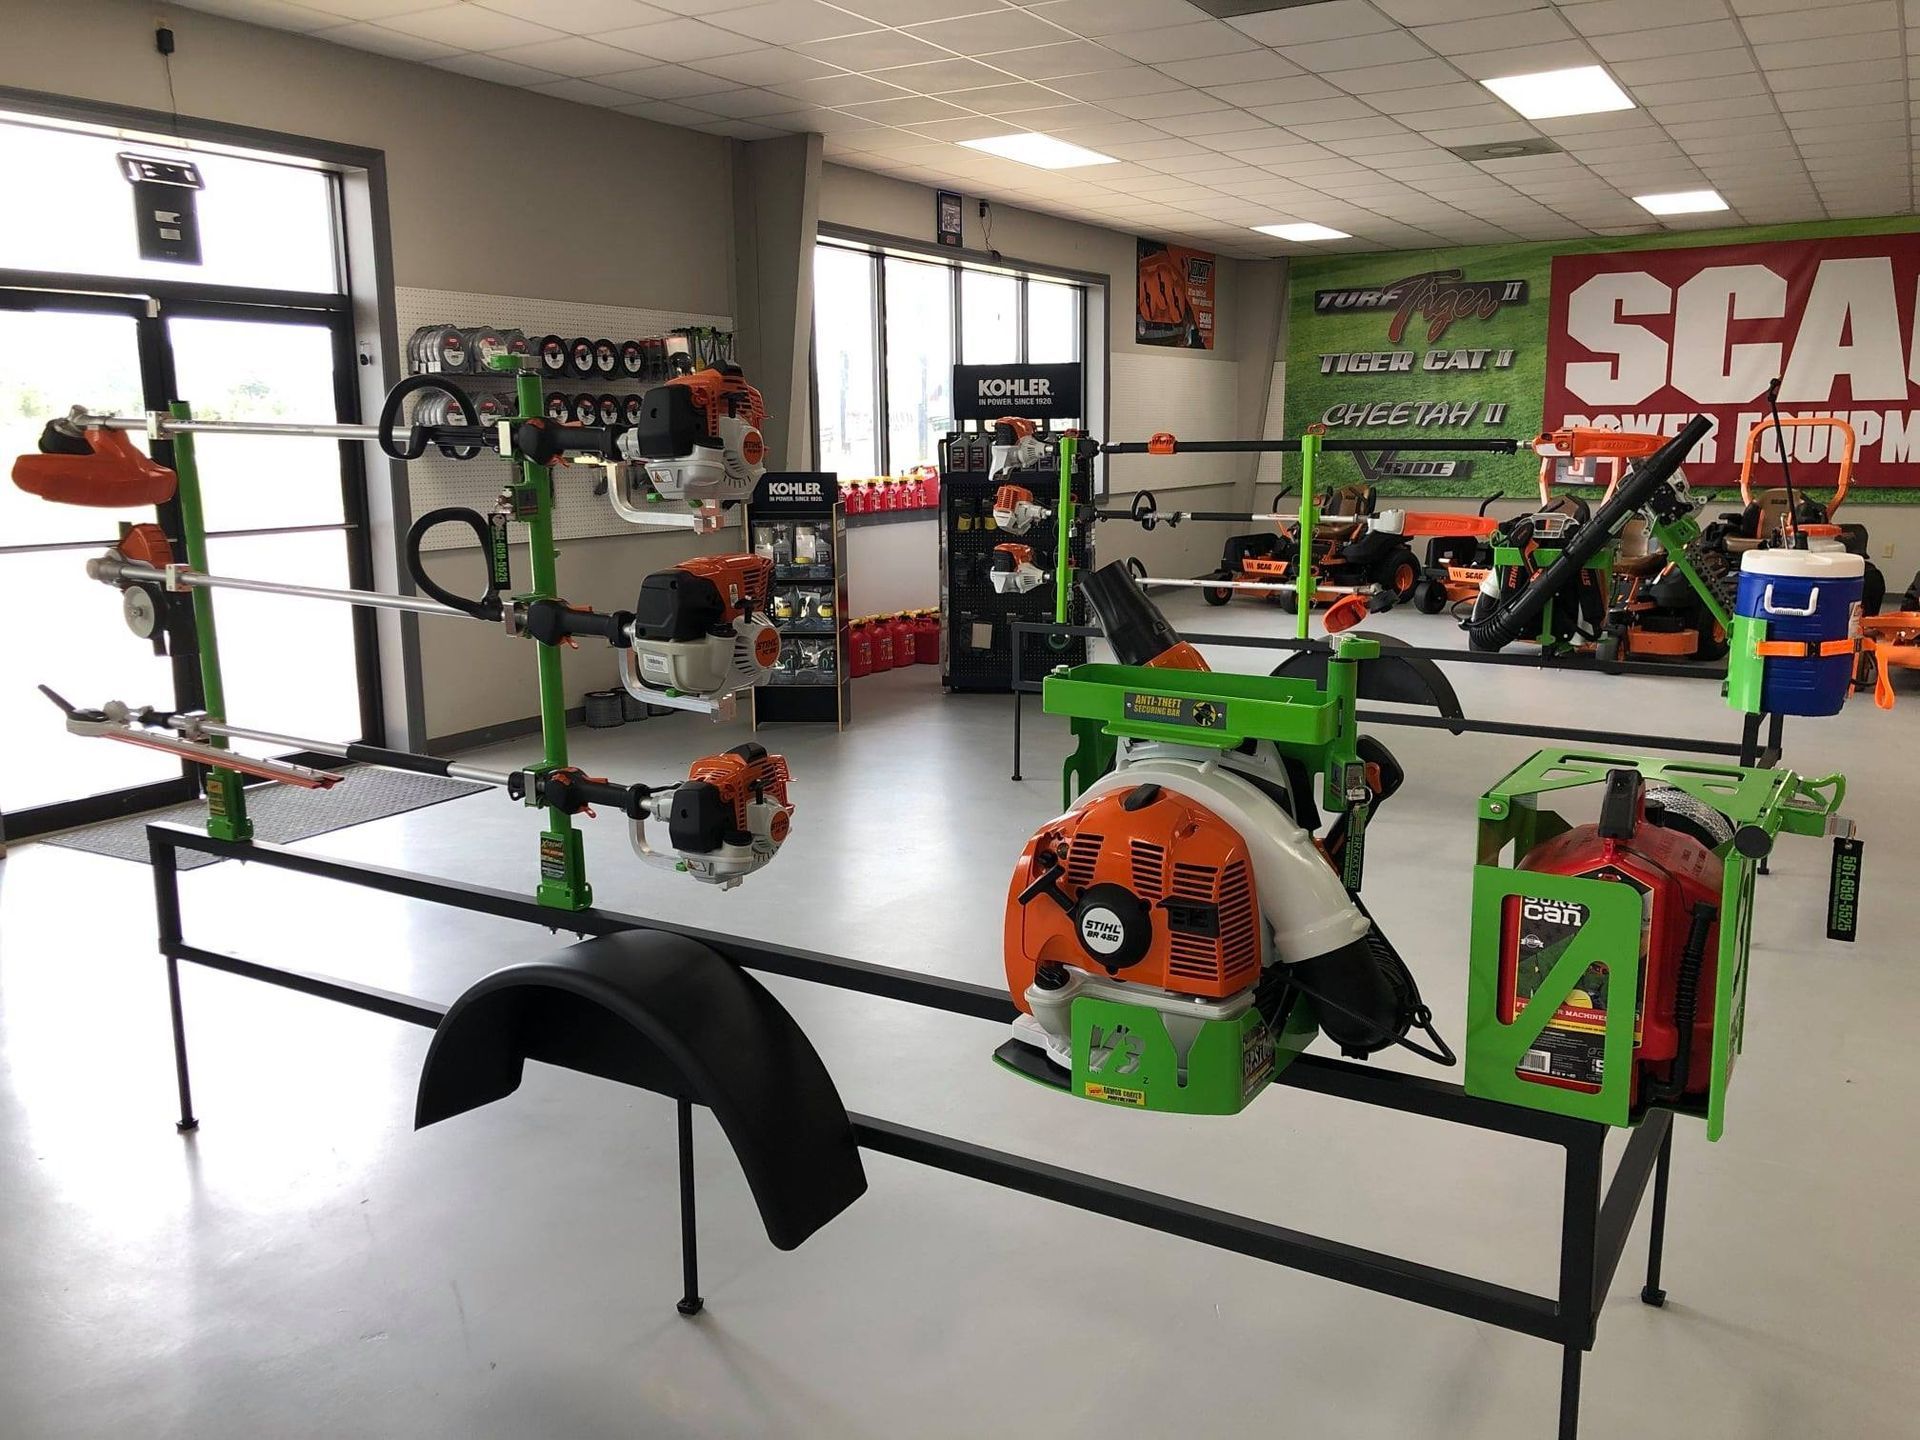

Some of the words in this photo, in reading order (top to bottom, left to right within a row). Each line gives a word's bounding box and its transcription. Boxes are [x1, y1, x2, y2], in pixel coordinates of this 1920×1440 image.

[1318, 290, 1401, 309] TURF
[1382, 268, 1498, 343] Tiger
[1501, 282, 1523, 300] II
[1565, 257, 1920, 406] SCA
[1320, 351, 1414, 373] TIGER
[1423, 349, 1491, 370] CAT
[1495, 350, 1514, 367] II
[979, 379, 1051, 396] KOHLER
[1322, 401, 1478, 426] CHEETAH
[1484, 403, 1506, 423] II
[769, 482, 821, 495] KOHLER
[1257, 562, 1271, 570] SCAG
[1465, 571, 1484, 580] SCAG
[1508, 565, 1519, 589] STIH
[1135, 694, 1182, 708] ANTI-THEFT
[1134, 704, 1166, 716] SECURING
[1167, 707, 1181, 717] BAR
[1837, 855, 1857, 932] 561-659-5525
[1524, 904, 1581, 926] can
[1085, 920, 1120, 934] STIHL
[1087, 930, 1099, 938] BR
[1100, 933, 1119, 942] 450
